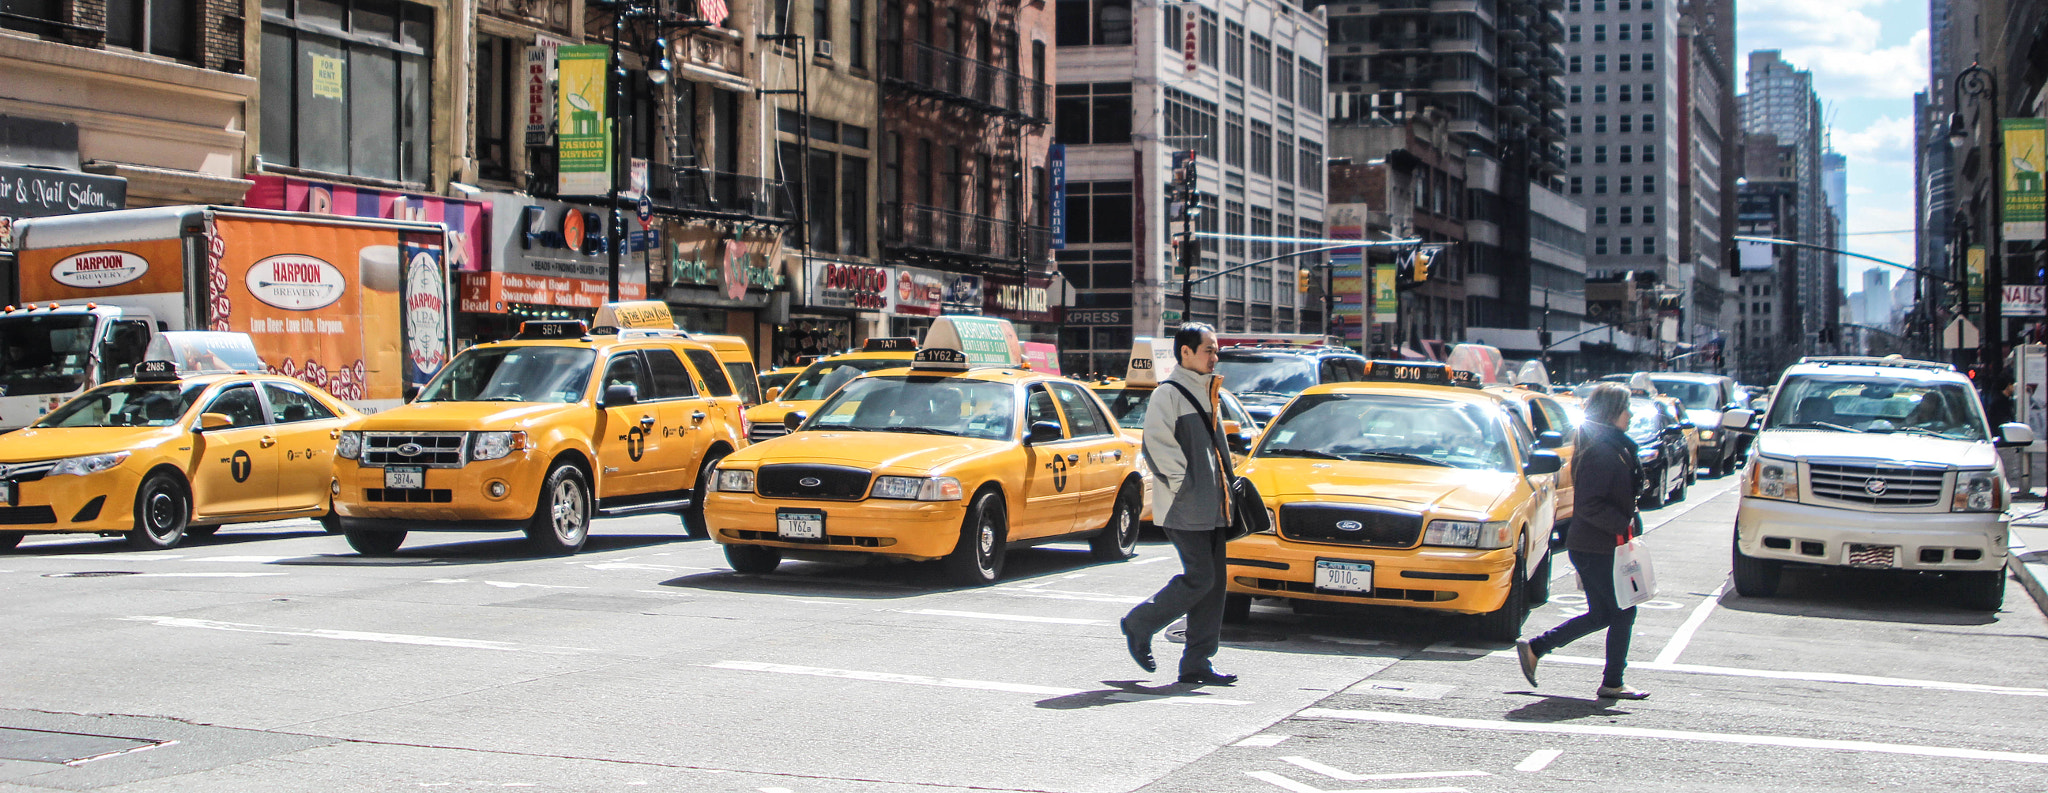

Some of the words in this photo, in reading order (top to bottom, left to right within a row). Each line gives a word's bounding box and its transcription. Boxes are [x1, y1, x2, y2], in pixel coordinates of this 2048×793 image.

[1185, 22, 1196, 60] PARK
[318, 69, 336, 80] RENT
[529, 64, 544, 124] BARBER
[559, 140, 604, 149] FASHION
[559, 150, 604, 158] DISTRICT
[0, 176, 12, 198] ir
[15, 177, 29, 203] &
[31, 179, 64, 208] Nail
[67, 182, 104, 211] Salon
[75, 255, 123, 271] HARPOON
[534, 261, 551, 271] BEADS
[76, 272, 122, 281] BREWERY
[272, 262, 321, 283] HARPOON
[827, 263, 887, 293] BONITO
[465, 273, 487, 287] Fun
[501, 277, 524, 288] Toho
[525, 278, 546, 289] Seed
[548, 280, 570, 292] Bead
[273, 287, 321, 298] BREWERY
[471, 287, 481, 300] 2
[500, 288, 547, 303] Swarovski
[554, 293, 573, 306] Soft
[574, 294, 593, 306] Flex
[2001, 286, 2043, 304] NAILS
[408, 292, 441, 314] HARPOON
[461, 300, 490, 312] Bead
[628, 311, 640, 321] THE
[638, 308, 655, 322] LION
[250, 317, 266, 332] Love
[267, 317, 285, 333] Beer.
[286, 317, 301, 333] Love
[301, 317, 317, 333] Life.
[317, 317, 345, 336] Harpoon.
[542, 324, 562, 335] 5B74
[955, 321, 1004, 341] FLASHDANCERS
[880, 340, 897, 349] 7A71
[962, 339, 994, 352] GENTLEMEN'S
[994, 341, 1007, 353] CLUB
[927, 350, 951, 361] 1Y62
[145, 362, 166, 372] 2N85
[1133, 359, 1152, 369] 4A16
[1394, 366, 1420, 380] 9D10
[630, 433, 641, 458] T
[235, 455, 247, 479] T
